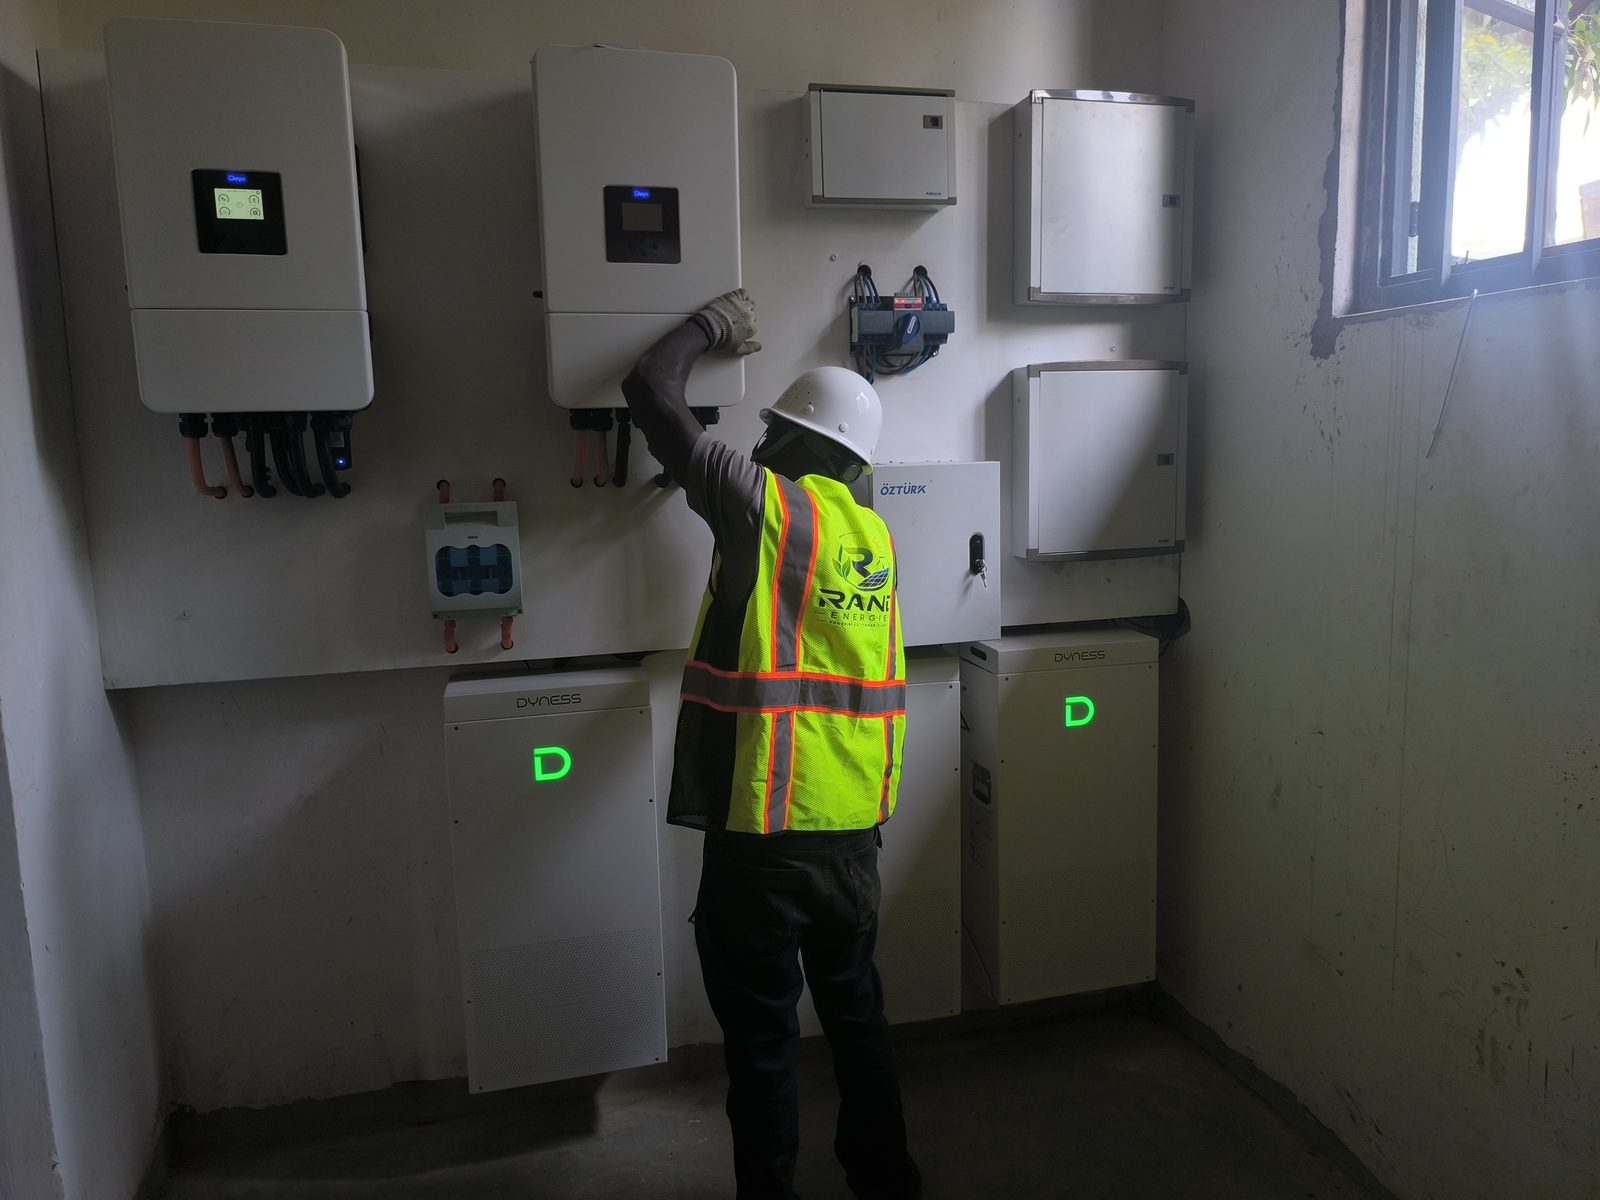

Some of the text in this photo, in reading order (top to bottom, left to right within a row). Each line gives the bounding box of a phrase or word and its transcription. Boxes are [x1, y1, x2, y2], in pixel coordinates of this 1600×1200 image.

[880, 482, 926, 496] ÖZTÜRK
[1054, 650, 1105, 662] DYNESS
[516, 693, 582, 708] DYNESS
